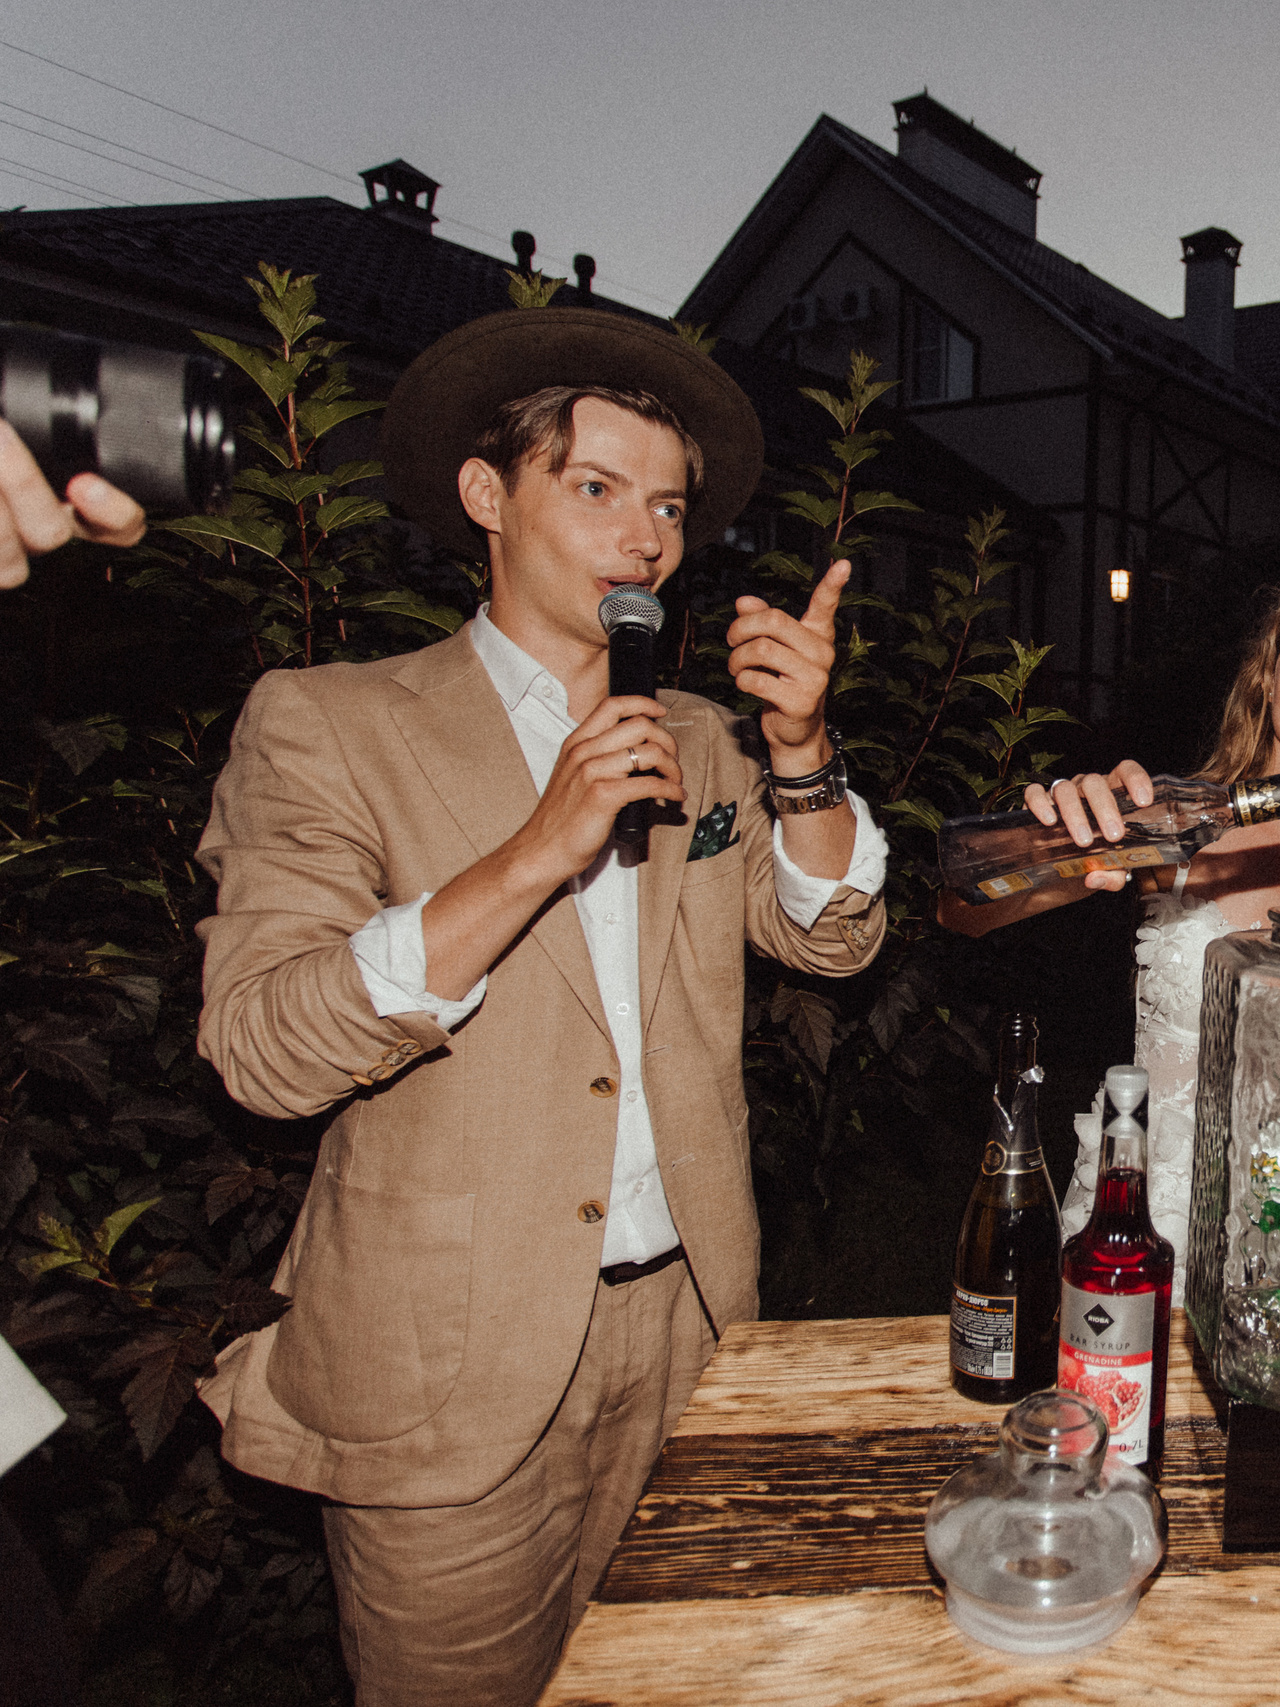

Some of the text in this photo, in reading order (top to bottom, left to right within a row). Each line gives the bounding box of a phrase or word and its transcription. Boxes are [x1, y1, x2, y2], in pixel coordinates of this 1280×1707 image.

[1087, 1315, 1110, 1324] RIOBA
[1069, 1333, 1131, 1351] BAR SYRUP
[1074, 1351, 1123, 1366] GRENADINE
